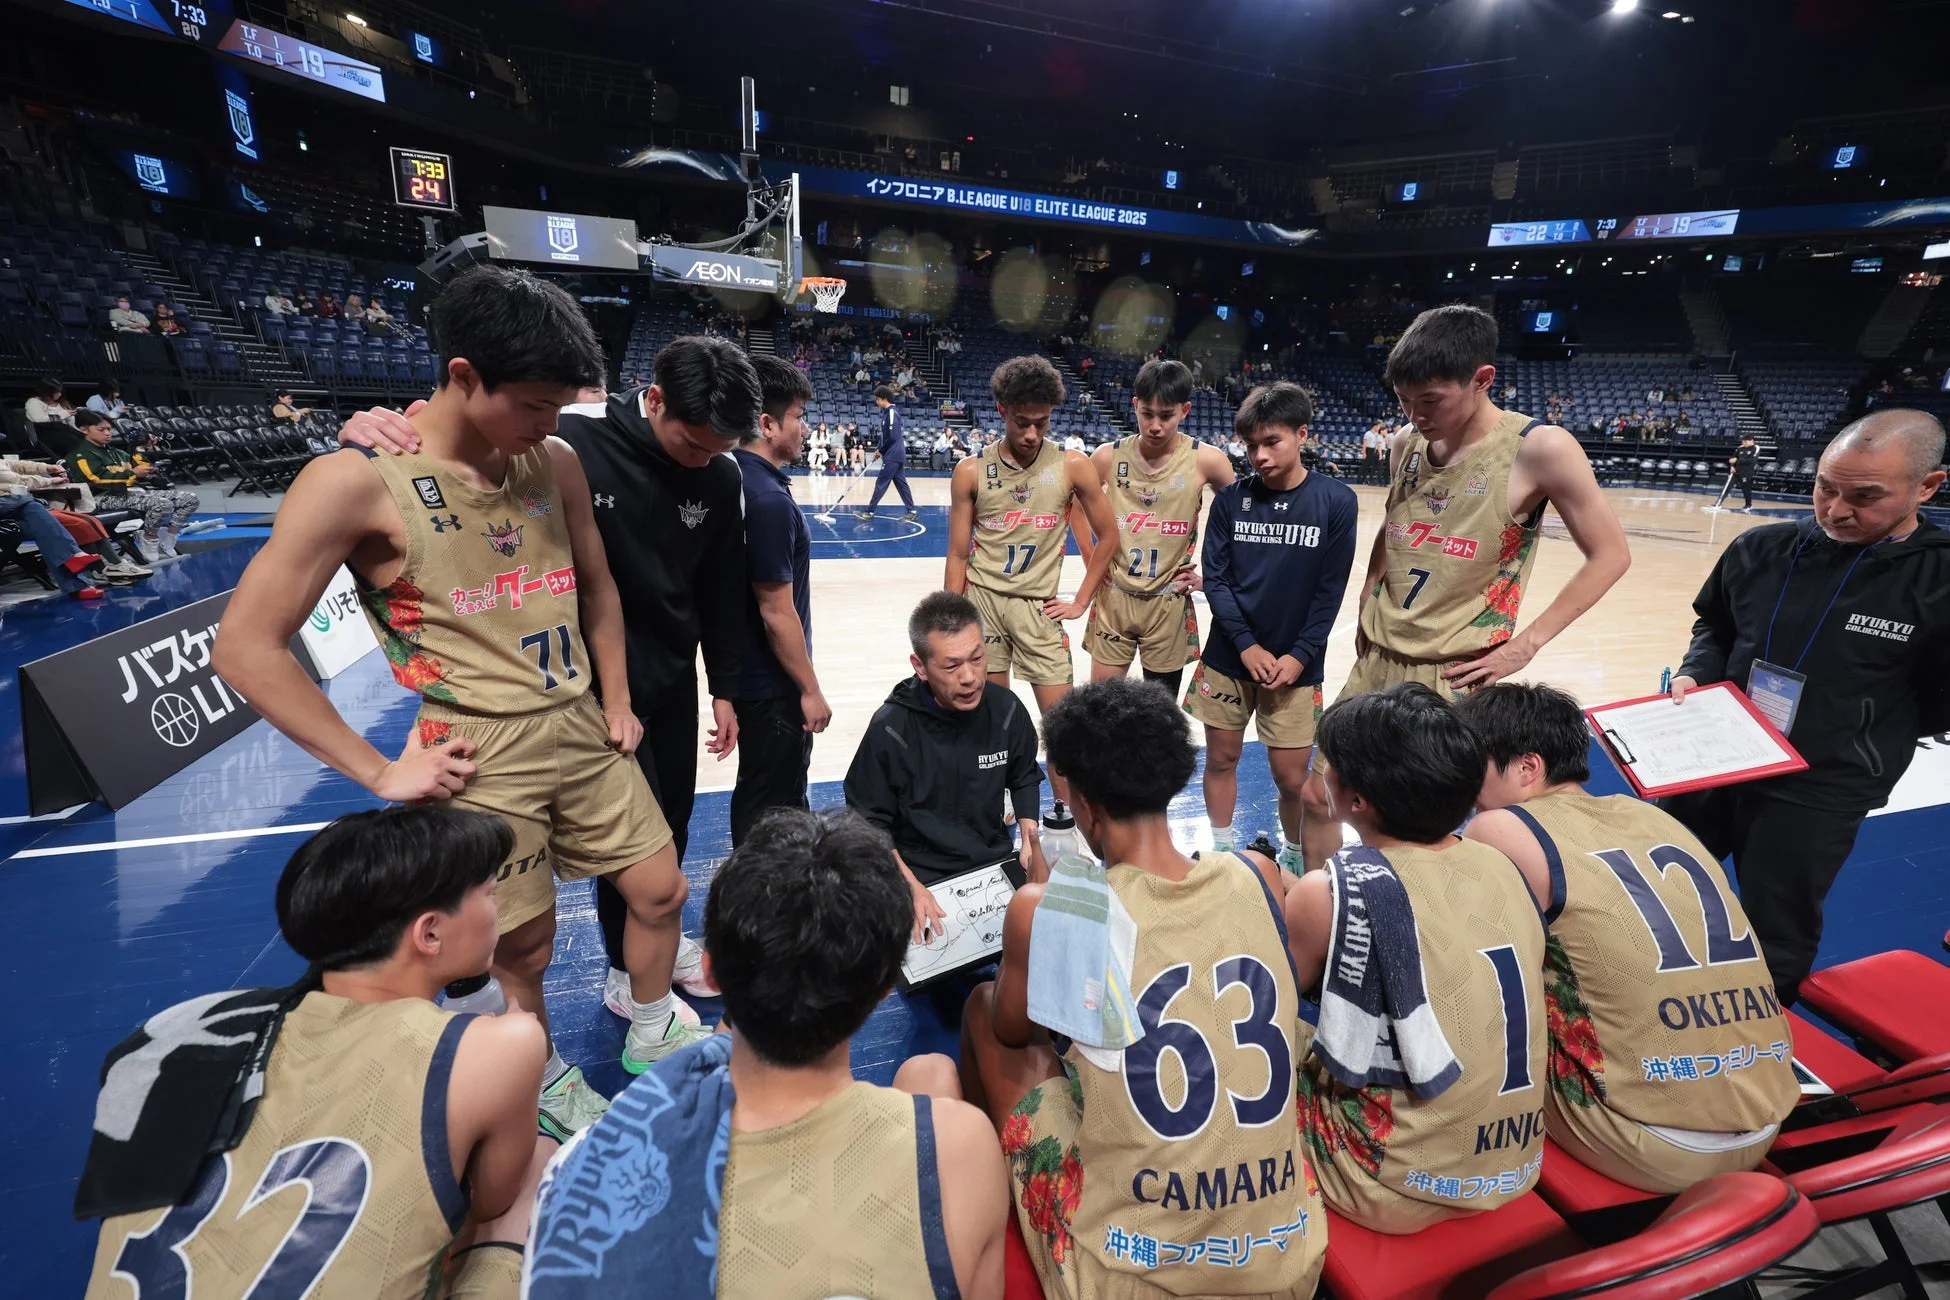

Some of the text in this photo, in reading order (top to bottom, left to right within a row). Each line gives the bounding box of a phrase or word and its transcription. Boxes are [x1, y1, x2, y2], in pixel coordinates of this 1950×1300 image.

[171, 0, 207, 26] 7:33
[241, 24, 280, 49] T.F 1
[298, 45, 327, 78] 19
[410, 159, 445, 180] 7:33
[411, 177, 440, 200] 24
[866, 178, 1147, 226] インフロニア B.LEAGUE U18 ELITE LEAGUE 2025
[553, 228, 573, 247] 18
[1526, 224, 1548, 241] 22
[1597, 219, 1617, 230] 7:33
[1671, 216, 1691, 235] 19
[1233, 533, 1282, 544] GOLDEN KINGS
[1234, 521, 1321, 548] RYUKYU U18
[1002, 544, 1037, 575] 17
[1128, 547, 1160, 579] 21
[1402, 568, 1432, 611] 7
[1844, 623, 1910, 642] GOLDEN KINGS
[1847, 613, 1916, 635] RYUKYU
[520, 624, 579, 691] 71
[1210, 691, 1242, 706] JTA
[978, 749, 1009, 764] RYUKYU
[496, 847, 547, 882] JTA
[1584, 842, 1760, 974] 12
[1475, 943, 1536, 1097] 1
[1122, 953, 1293, 1143] 63
[1132, 1150, 1297, 1211] CAMARA
[1103, 1206, 1309, 1270] 沖縄ファミリーマート
